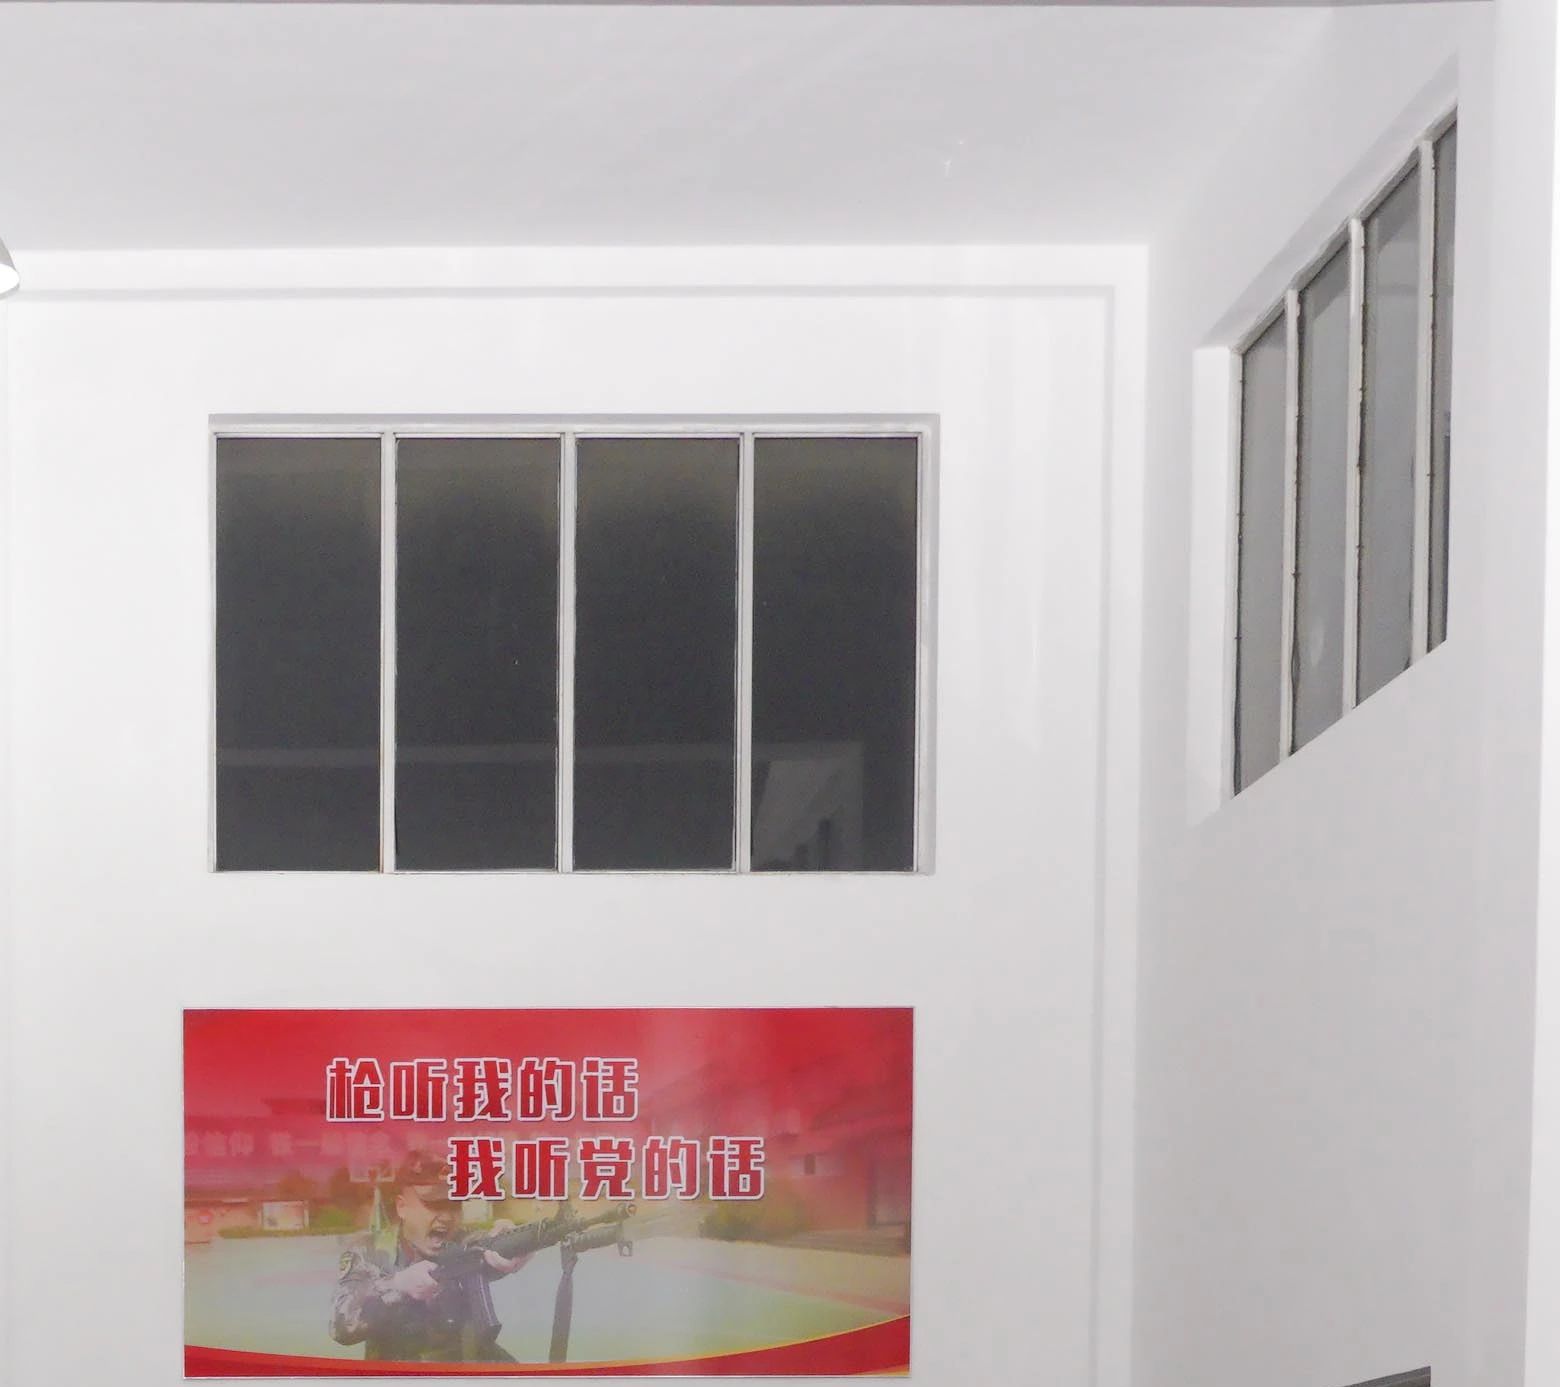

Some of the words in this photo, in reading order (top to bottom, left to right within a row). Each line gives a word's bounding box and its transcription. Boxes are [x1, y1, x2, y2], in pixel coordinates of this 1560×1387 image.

[325, 1056, 639, 1122] 枪听我的话
[446, 1136, 766, 1200] 我听党的话
